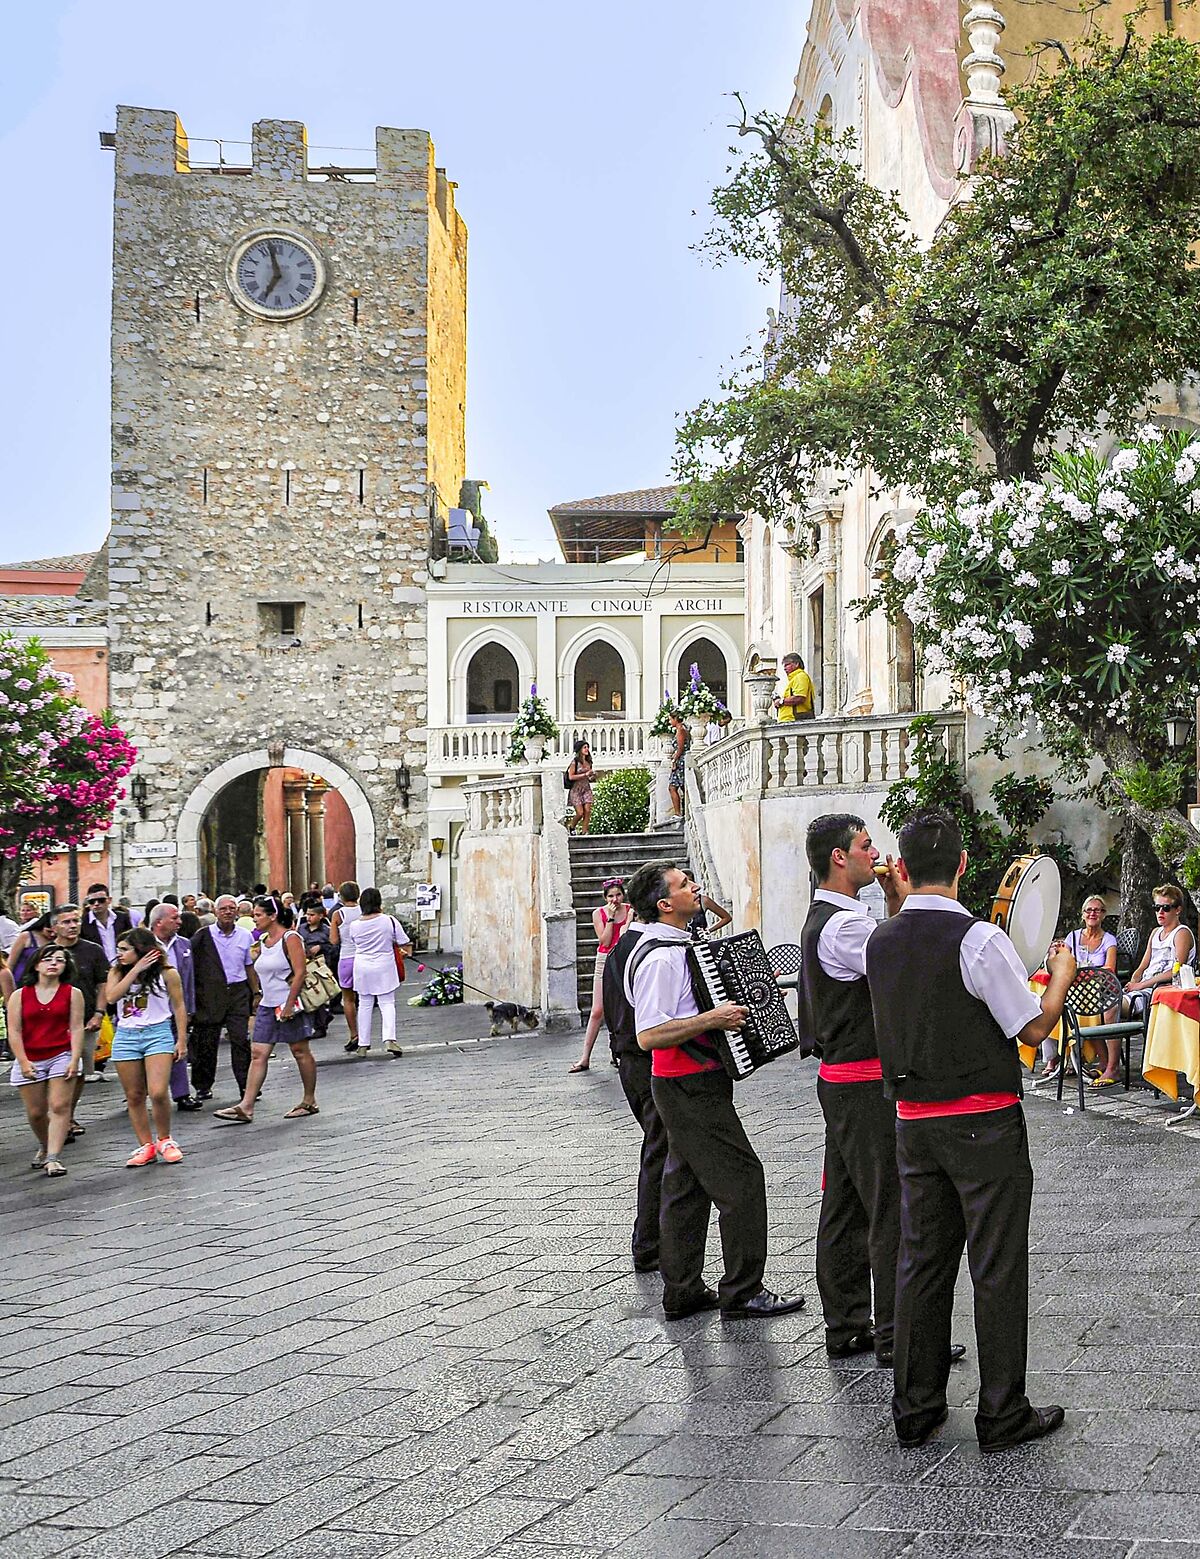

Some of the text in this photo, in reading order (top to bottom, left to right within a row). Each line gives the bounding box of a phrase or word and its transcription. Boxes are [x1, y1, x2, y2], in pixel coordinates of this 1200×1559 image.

[462, 598, 723, 613] RISTORANTE CINQUE ARCHI
